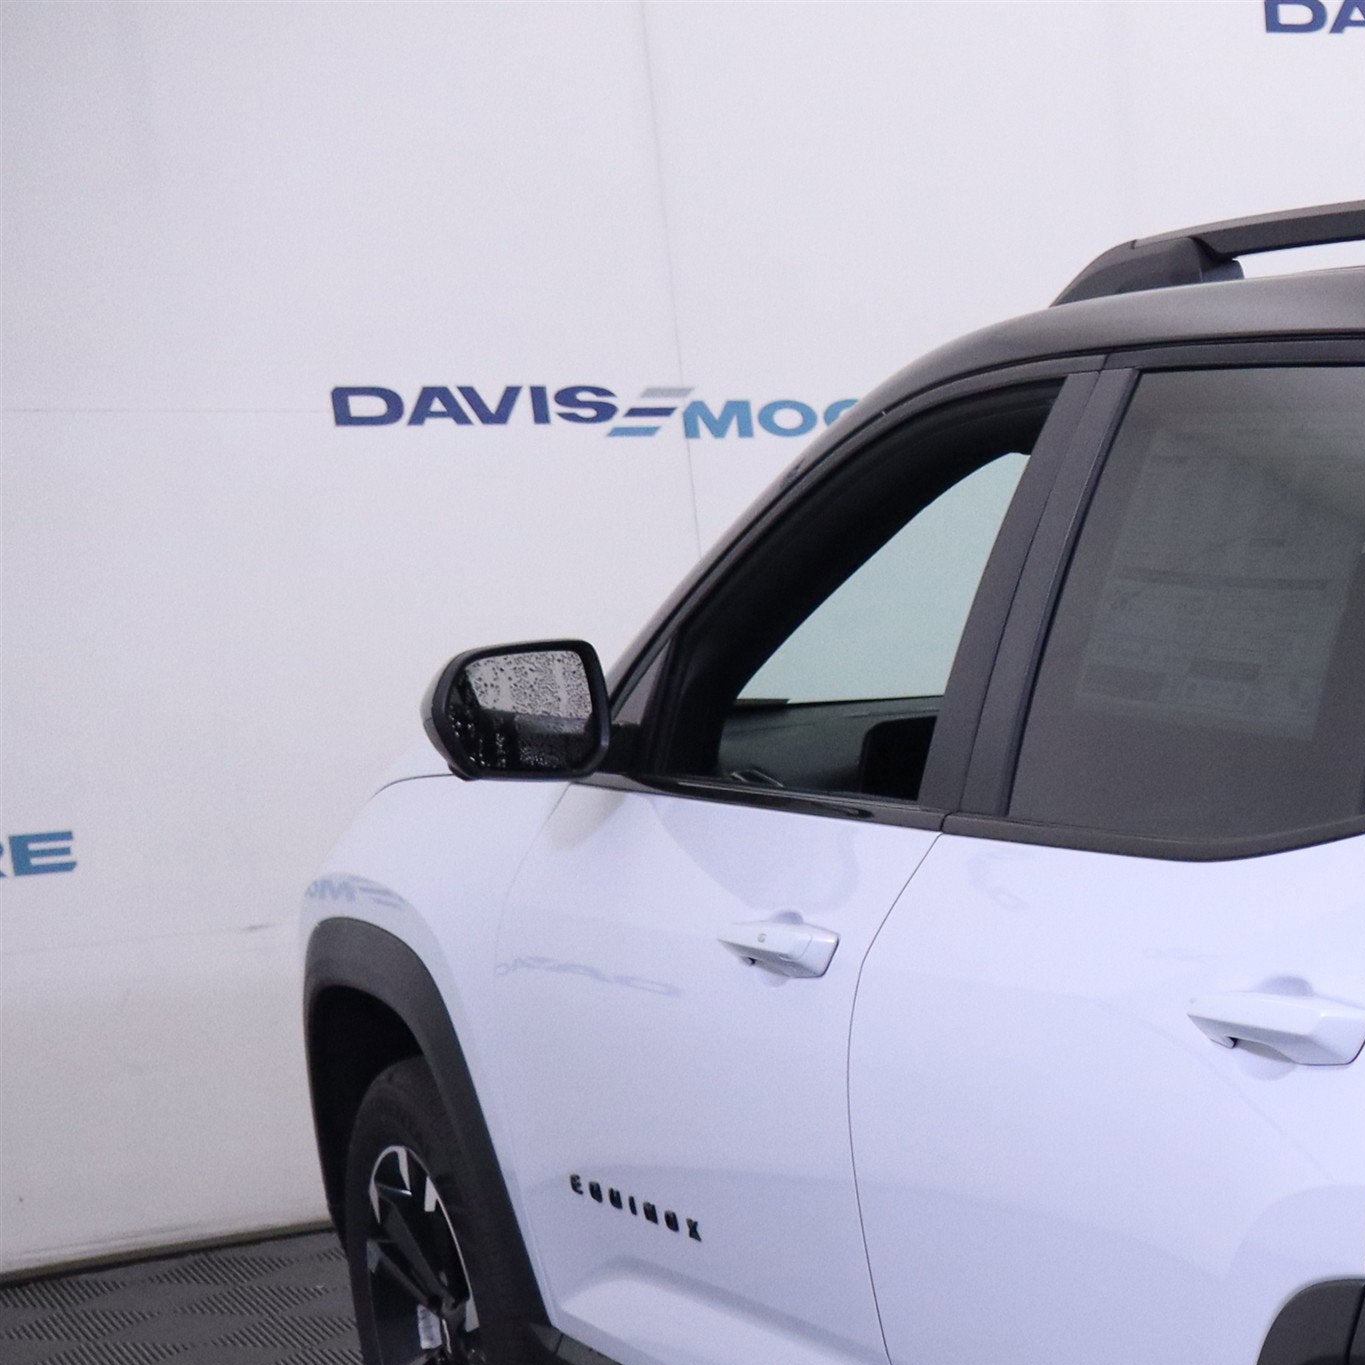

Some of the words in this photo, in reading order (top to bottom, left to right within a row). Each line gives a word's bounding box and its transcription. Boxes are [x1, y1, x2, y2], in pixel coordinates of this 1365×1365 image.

[329, 385, 620, 427] DAVIS
[683, 398, 858, 439] MO
[569, 1173, 702, 1242] EQUINOX
